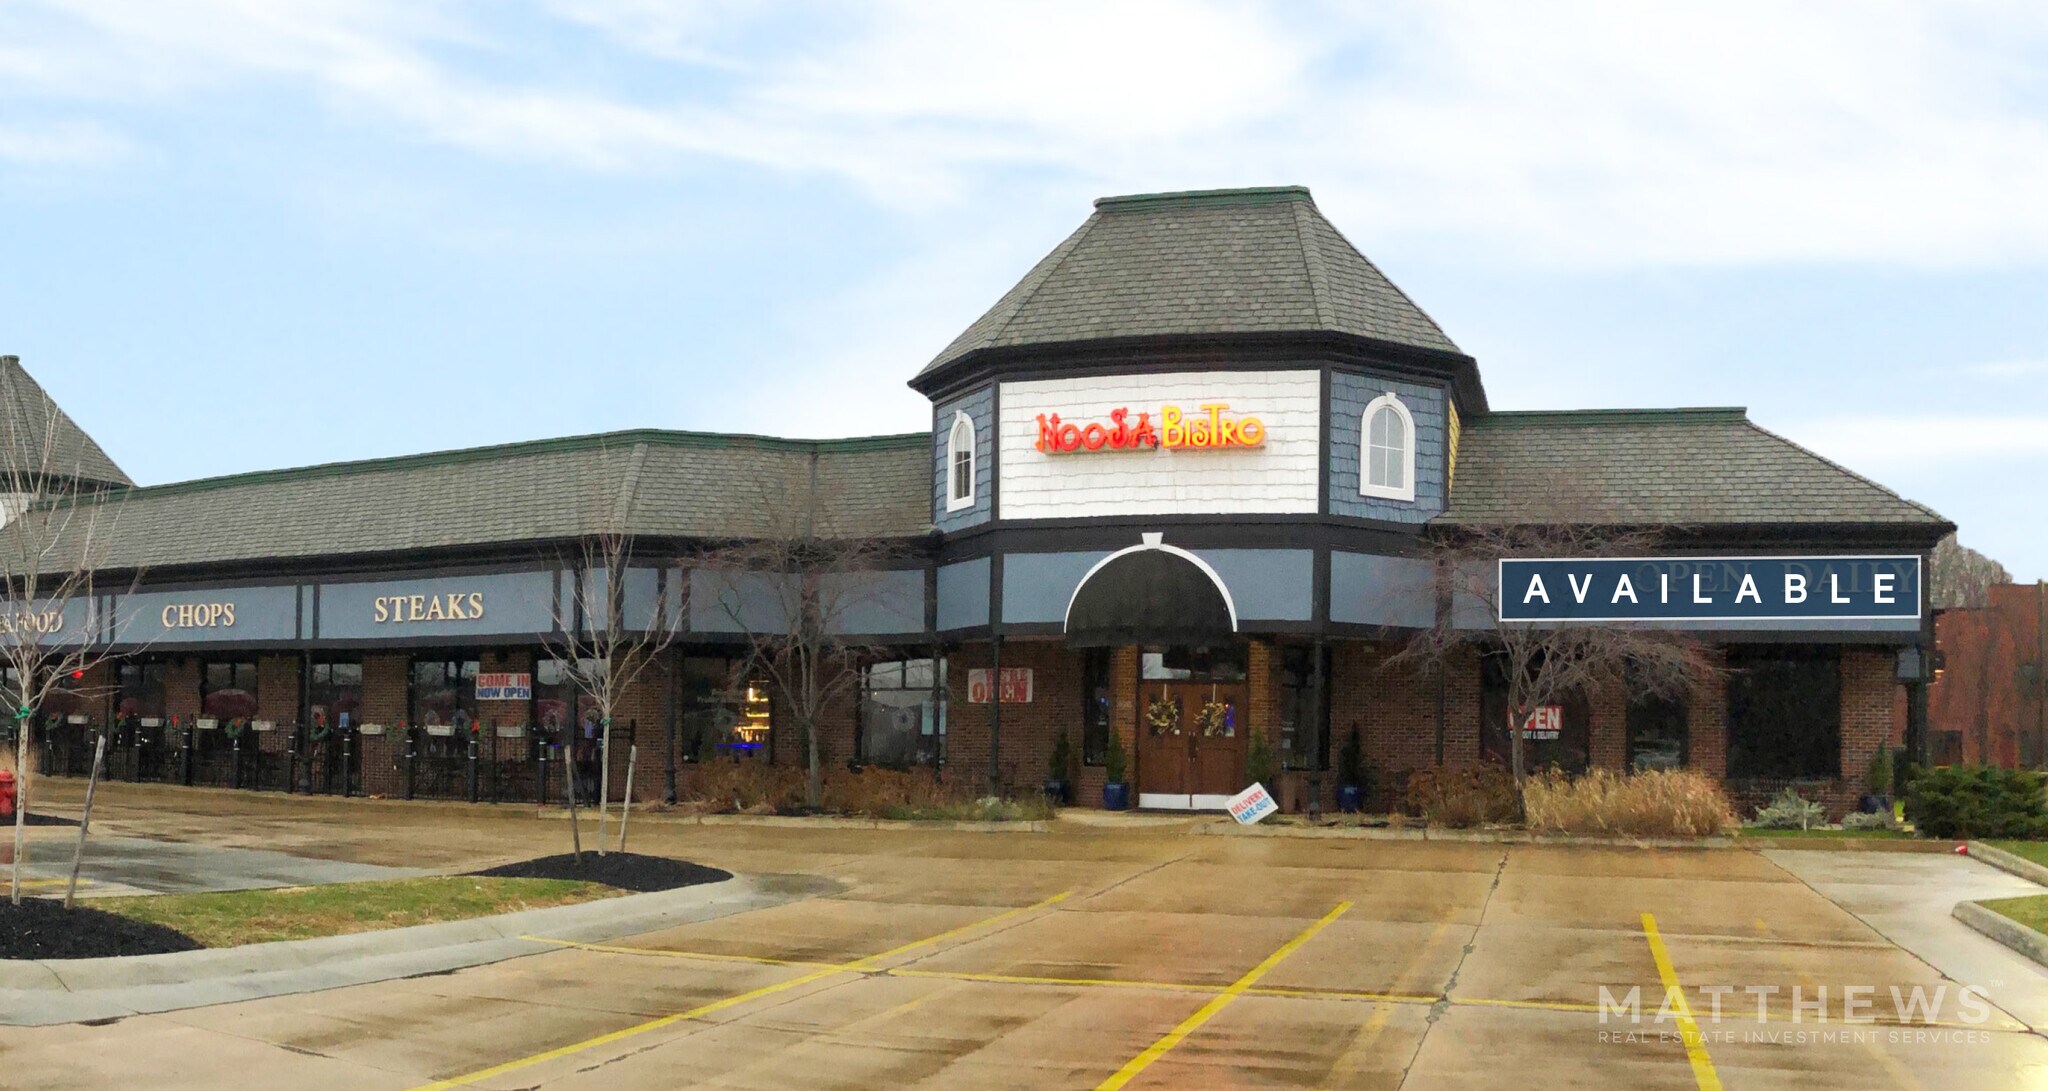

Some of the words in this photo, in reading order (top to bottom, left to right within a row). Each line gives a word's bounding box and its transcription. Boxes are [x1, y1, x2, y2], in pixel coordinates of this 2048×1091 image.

[161, 603, 236, 628] CHOPS
[374, 592, 485, 622] STEAKS
[477, 687, 501, 698] NOW
[504, 687, 530, 698] OPEN
[478, 675, 512, 687] COME
[517, 675, 529, 687] IN
[1231, 790, 1264, 814] DELIVERY
[1237, 797, 1271, 822] TAKE-OUT
